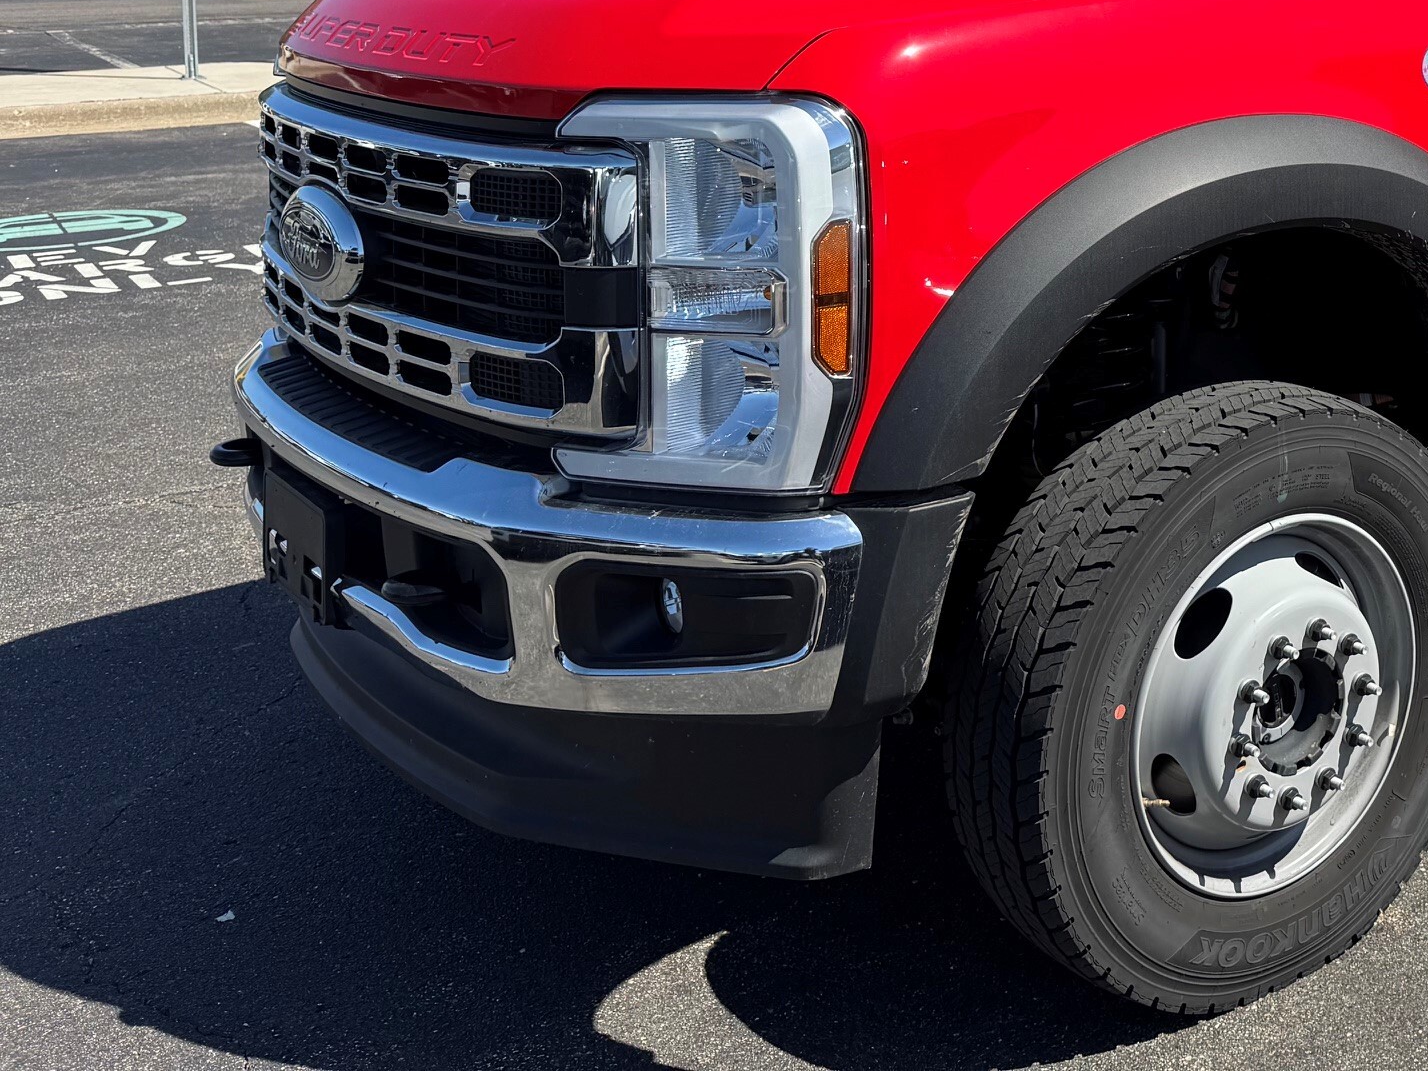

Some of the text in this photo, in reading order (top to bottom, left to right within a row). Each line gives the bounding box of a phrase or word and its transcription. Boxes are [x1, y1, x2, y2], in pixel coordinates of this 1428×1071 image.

[372, 25, 517, 66] DUTY
[7, 240, 157, 269] EV
[286, 217, 321, 270] Ford
[1367, 472, 1413, 508] Regional
